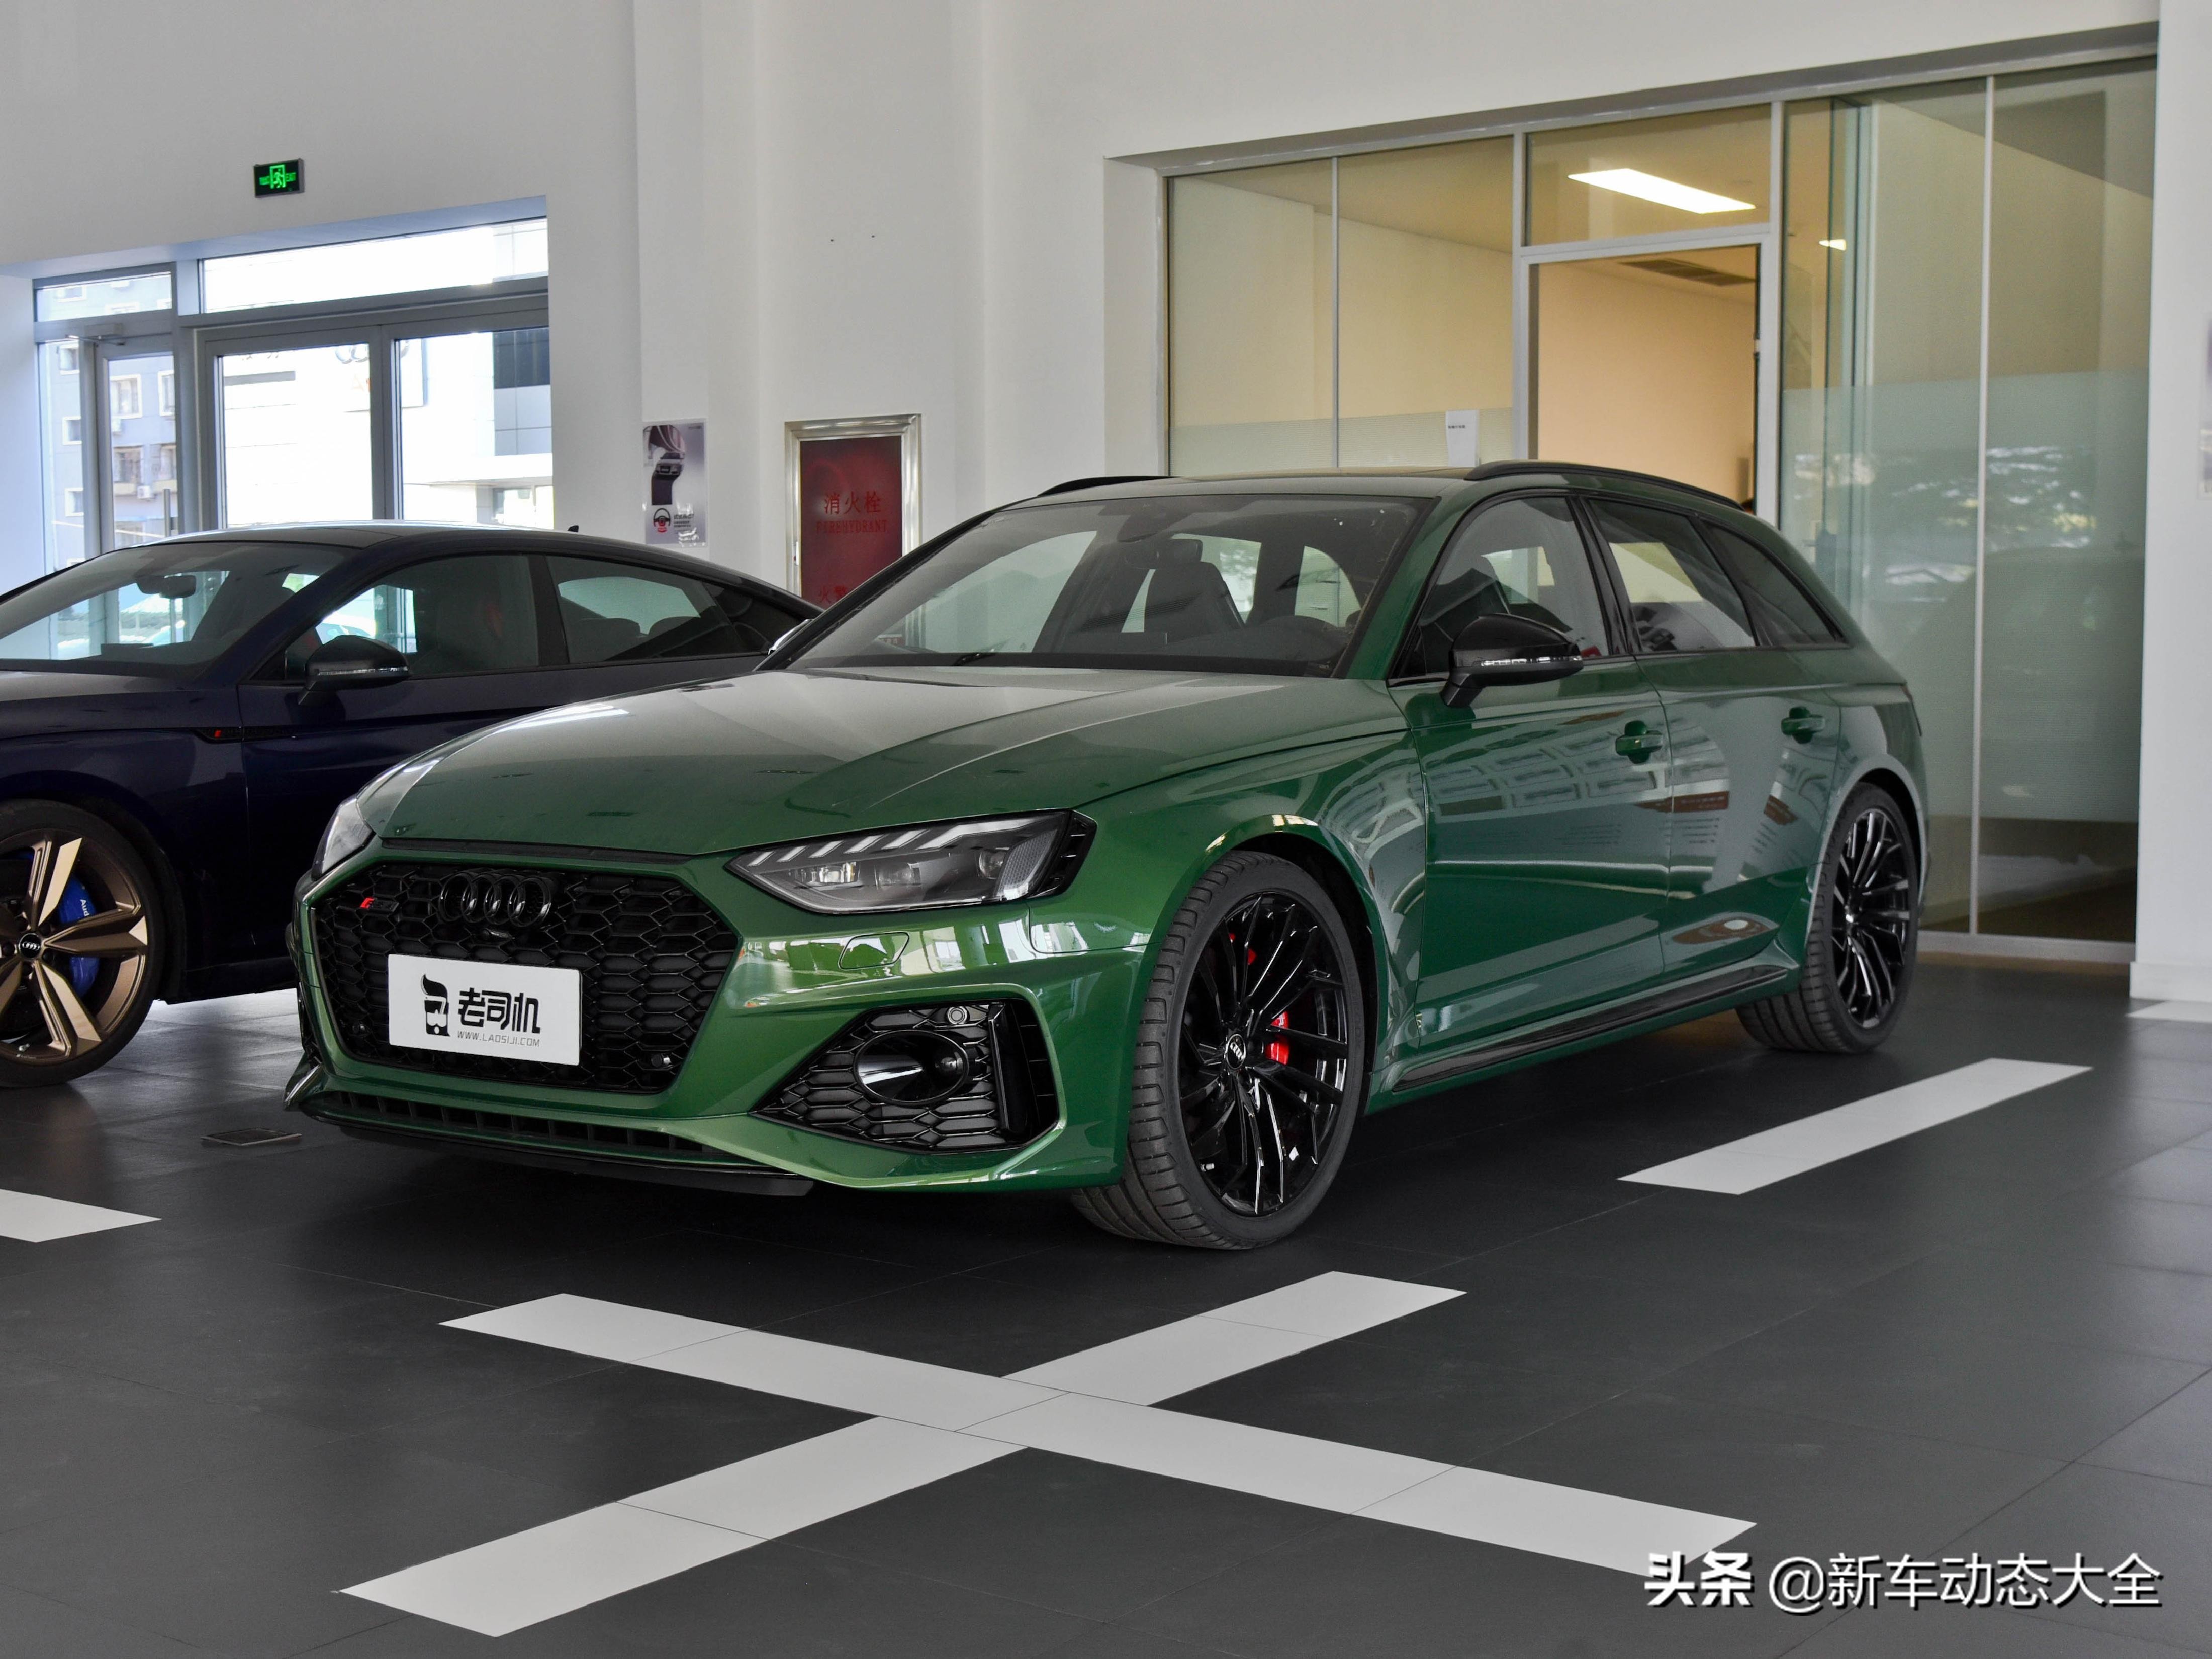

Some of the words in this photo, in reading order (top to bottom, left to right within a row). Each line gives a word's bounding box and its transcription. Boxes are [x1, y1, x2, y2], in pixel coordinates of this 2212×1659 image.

[824, 490, 881, 515] 消火栓
[80, 899, 90, 917] Aud
[458, 988, 540, 1033] 老司机
[457, 1031, 540, 1046] WWW.LAOSIJI.COM
